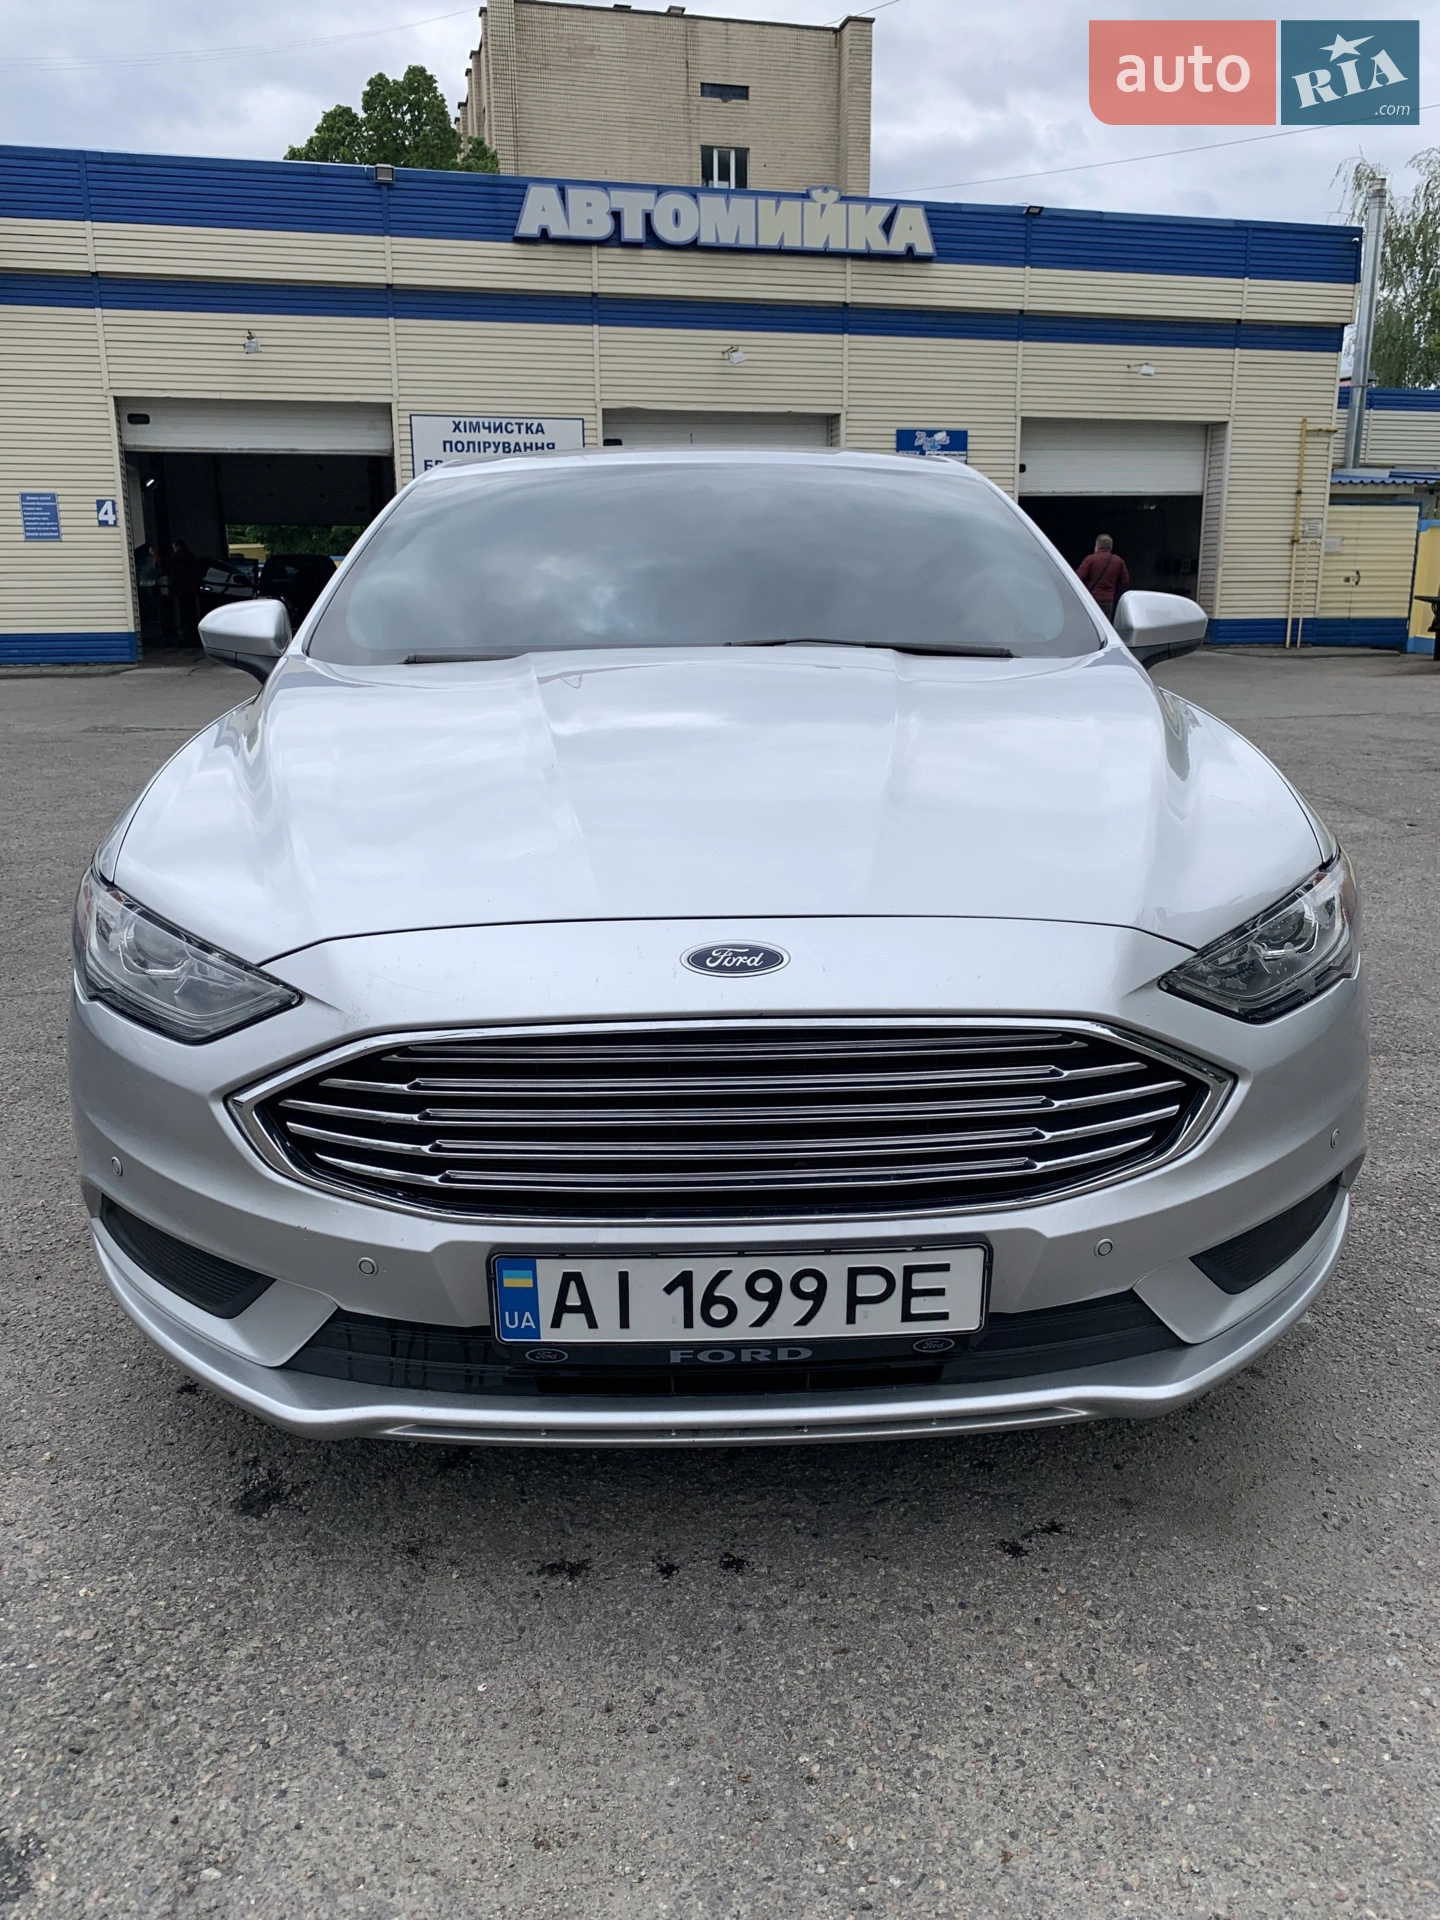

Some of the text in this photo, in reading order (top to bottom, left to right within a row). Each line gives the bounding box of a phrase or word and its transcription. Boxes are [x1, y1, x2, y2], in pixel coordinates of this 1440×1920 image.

[514, 183, 937, 257] АВТОМИЙКА
[452, 420, 545, 435] ХІМЧИСТКА
[98, 500, 116, 525] 4
[706, 948, 764, 968] Ford
[505, 1263, 951, 1330] UA AI 1699 PE
[669, 1347, 813, 1364] FORD
